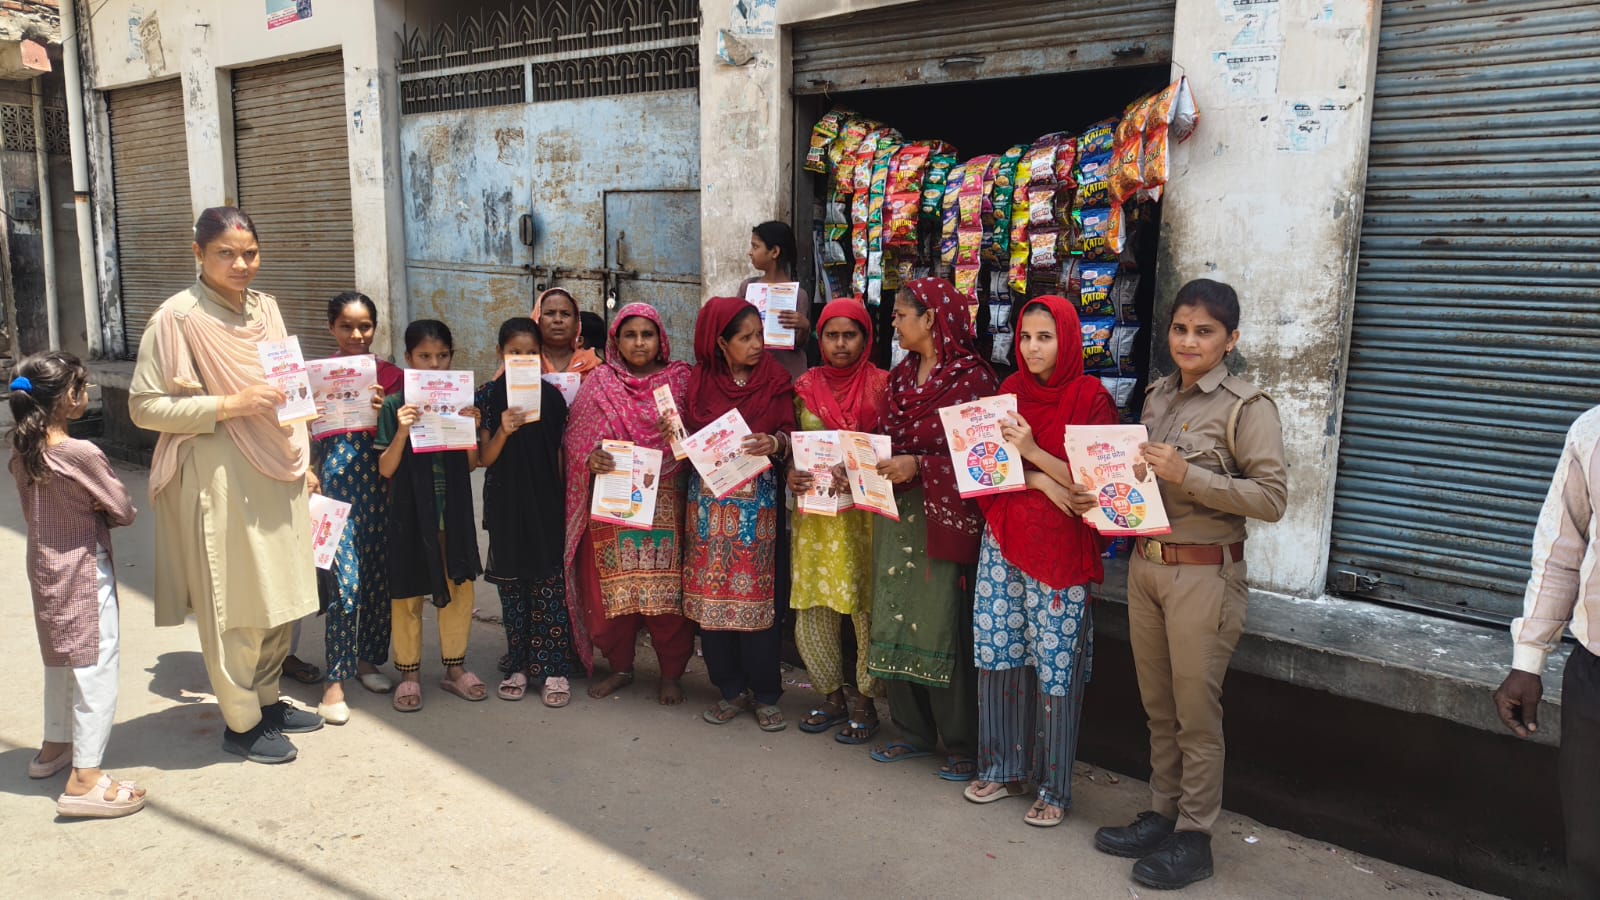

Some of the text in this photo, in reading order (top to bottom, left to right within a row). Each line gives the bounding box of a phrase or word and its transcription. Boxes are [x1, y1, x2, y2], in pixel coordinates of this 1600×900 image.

[1084, 128, 1112, 146] KATORI
[1083, 181, 1108, 198] KATOR
[1083, 237, 1105, 252] KATO
